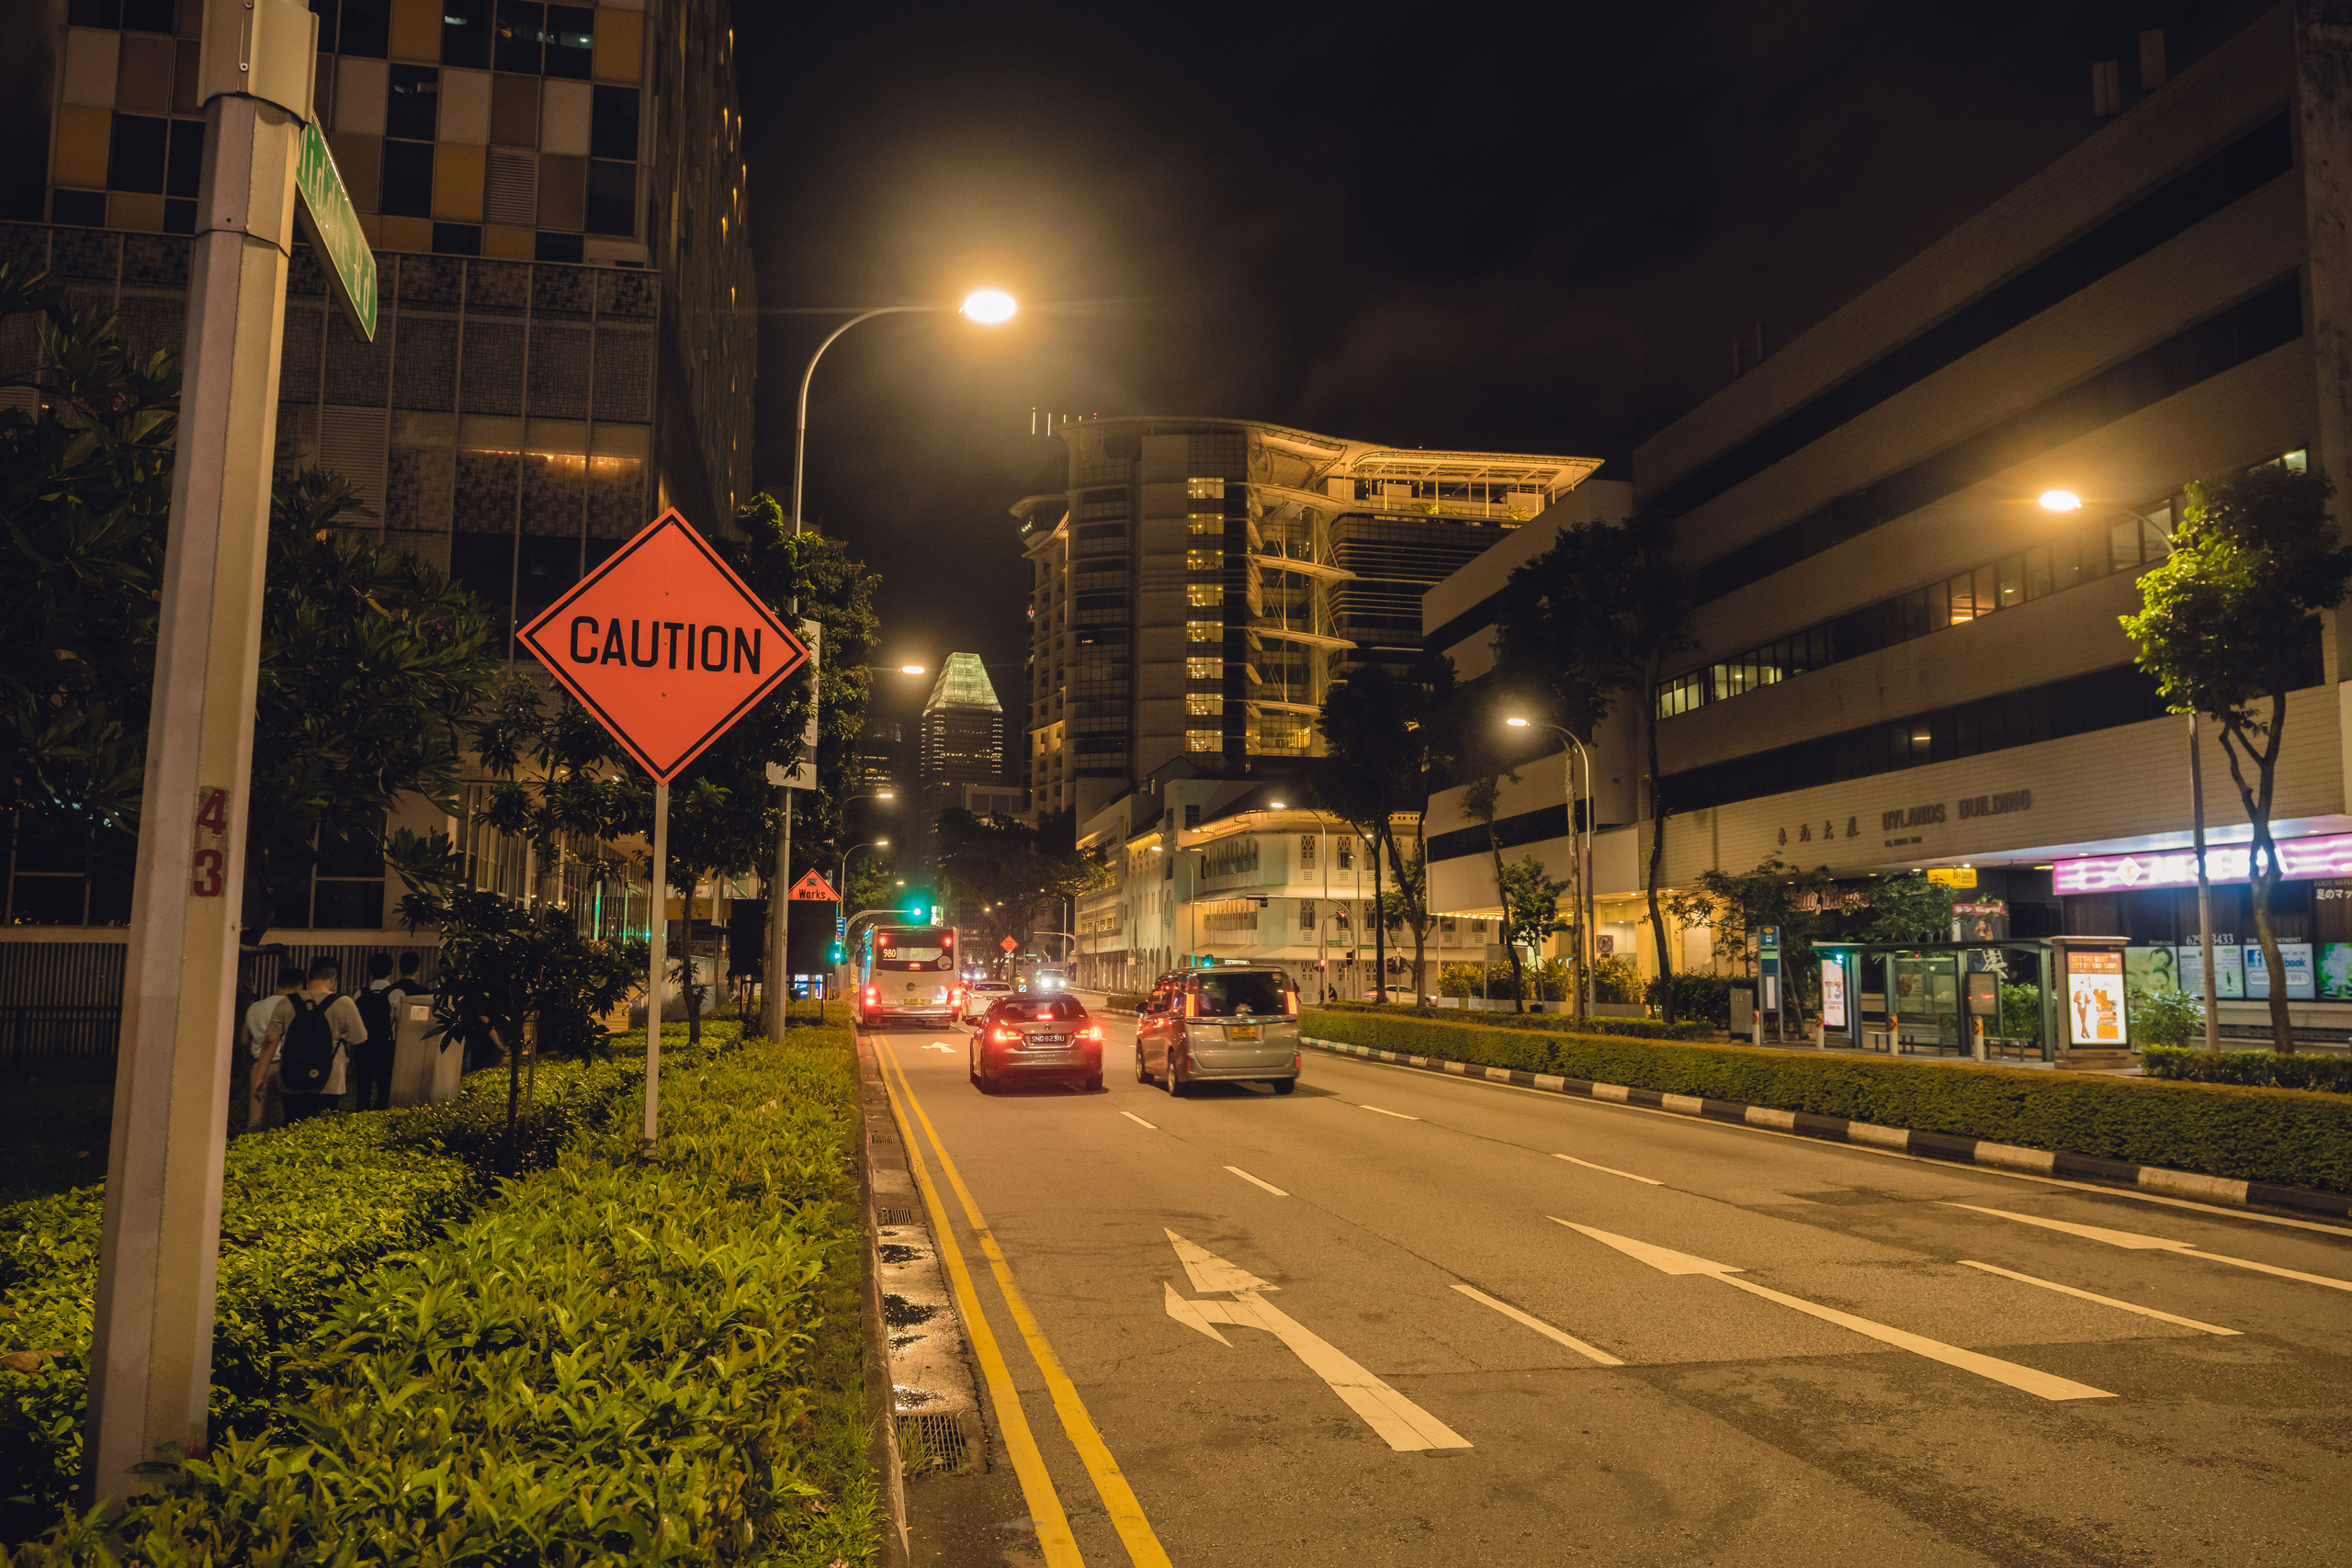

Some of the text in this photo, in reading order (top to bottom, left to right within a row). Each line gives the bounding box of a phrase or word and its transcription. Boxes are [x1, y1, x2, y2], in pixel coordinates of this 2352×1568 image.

[354, 242, 371, 320] Rd
[570, 615, 762, 675] CAUTION
[1883, 789, 2031, 831] BYLANDS BUILDING
[798, 888, 826, 900] Works
[883, 948, 897, 958] 980
